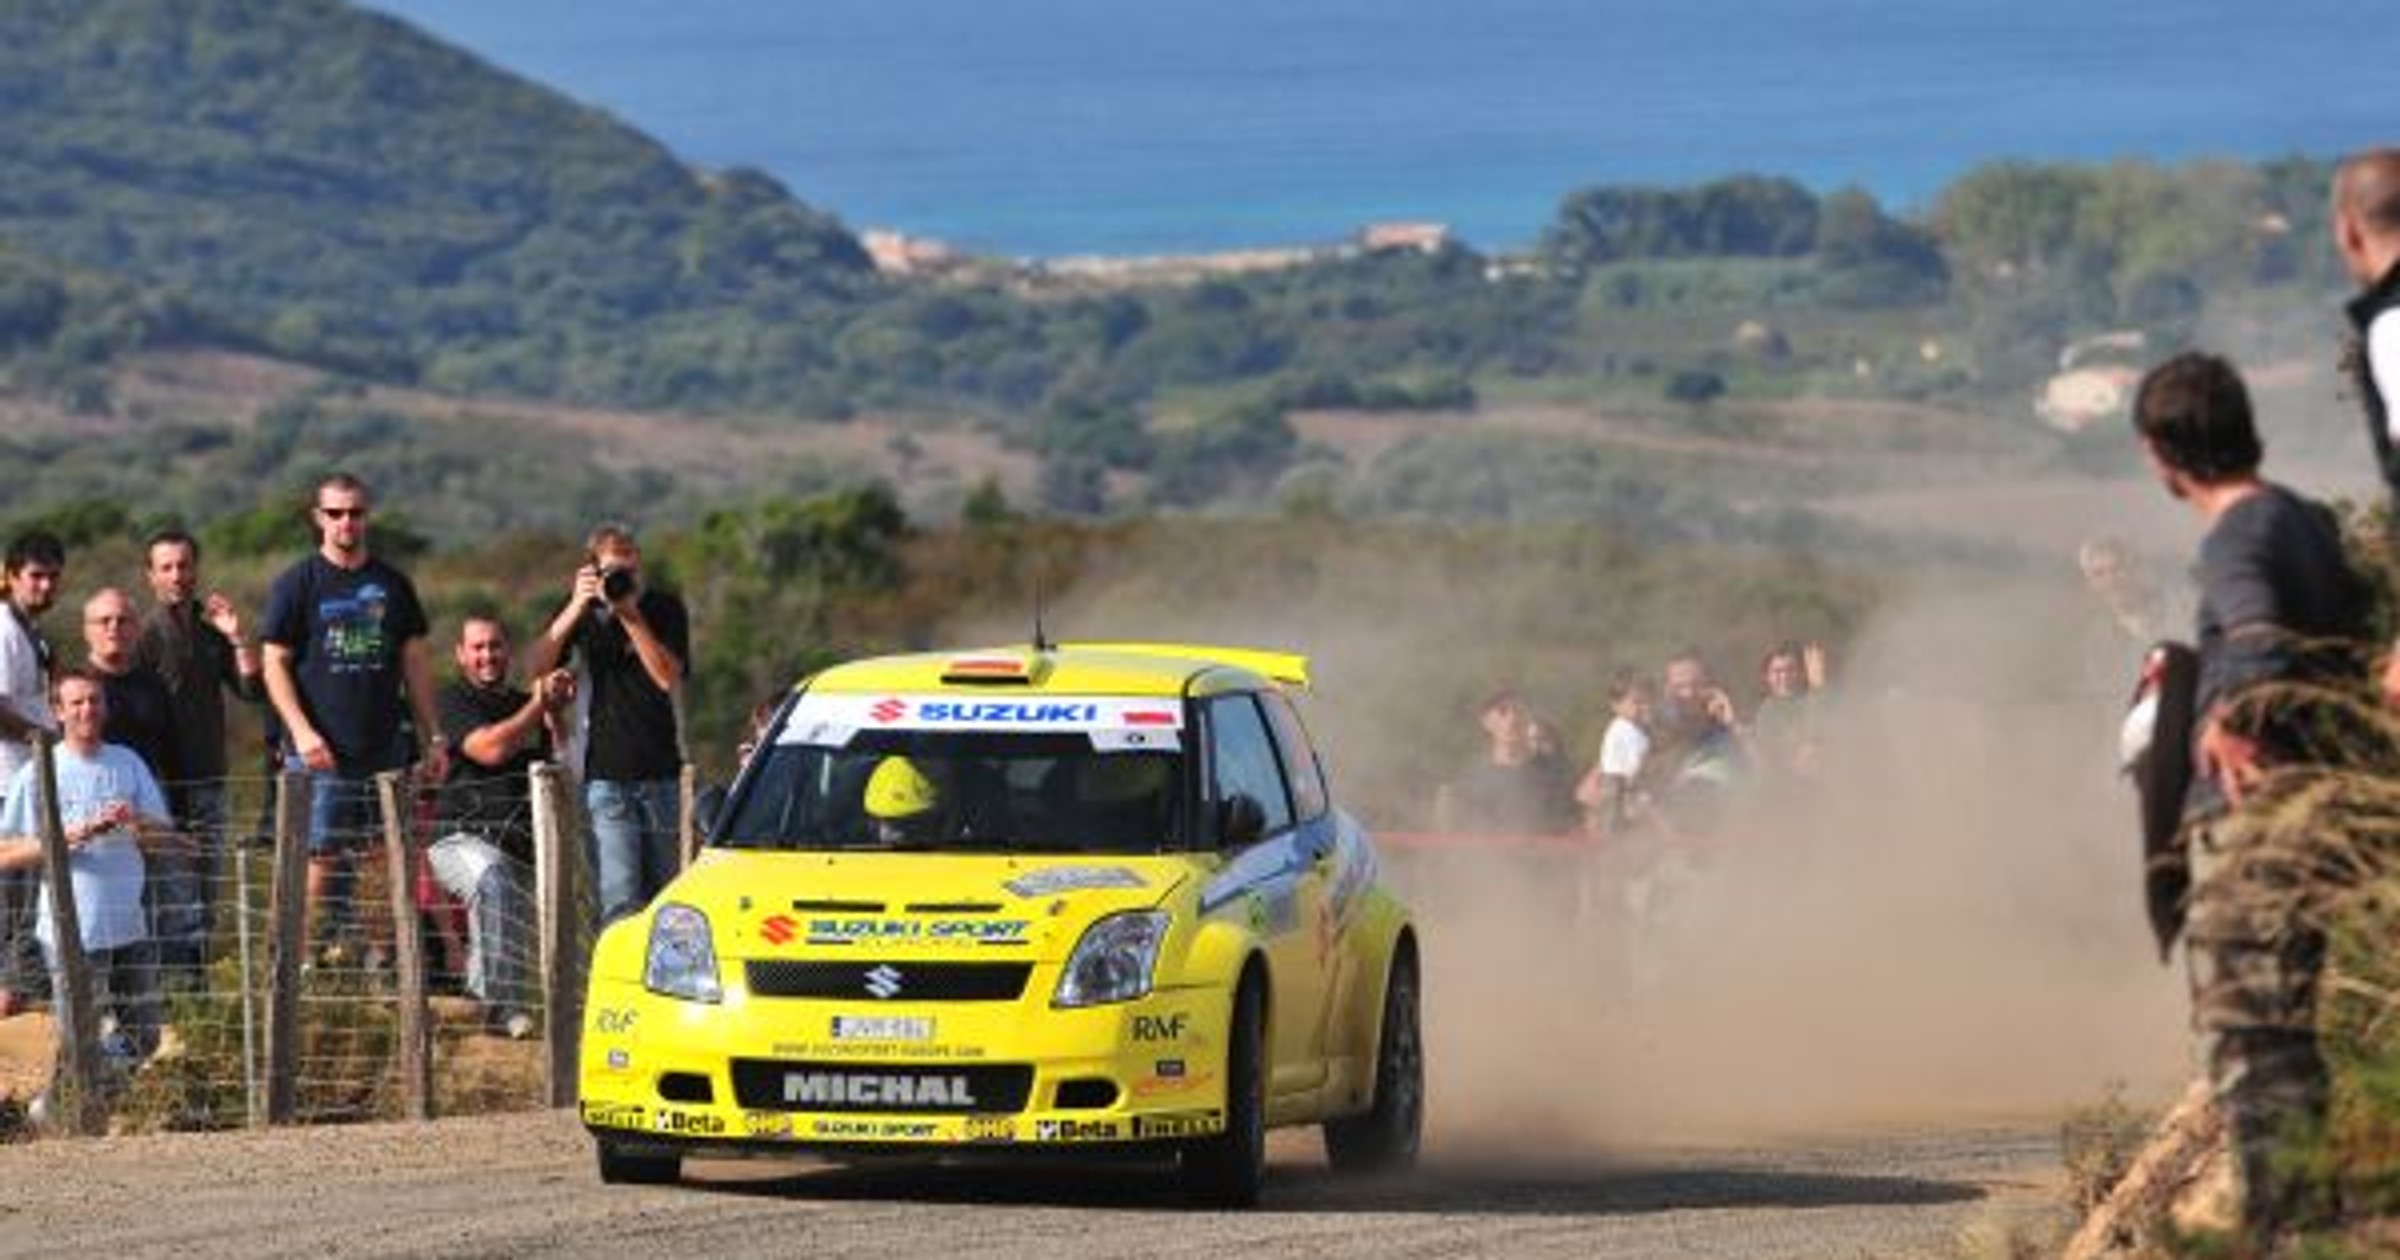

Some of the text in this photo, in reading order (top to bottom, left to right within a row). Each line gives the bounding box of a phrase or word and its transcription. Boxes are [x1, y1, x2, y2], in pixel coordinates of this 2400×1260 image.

[918, 703, 1098, 723] SUZUKI
[808, 920, 1032, 938] SUZUKI SPORT
[1132, 1012, 1189, 1041] RMF
[783, 1073, 977, 1106] MICHAL
[671, 1111, 726, 1133] Beta
[812, 1120, 939, 1137] SUZUKI SPORT
[1059, 1120, 1117, 1137] Beta
